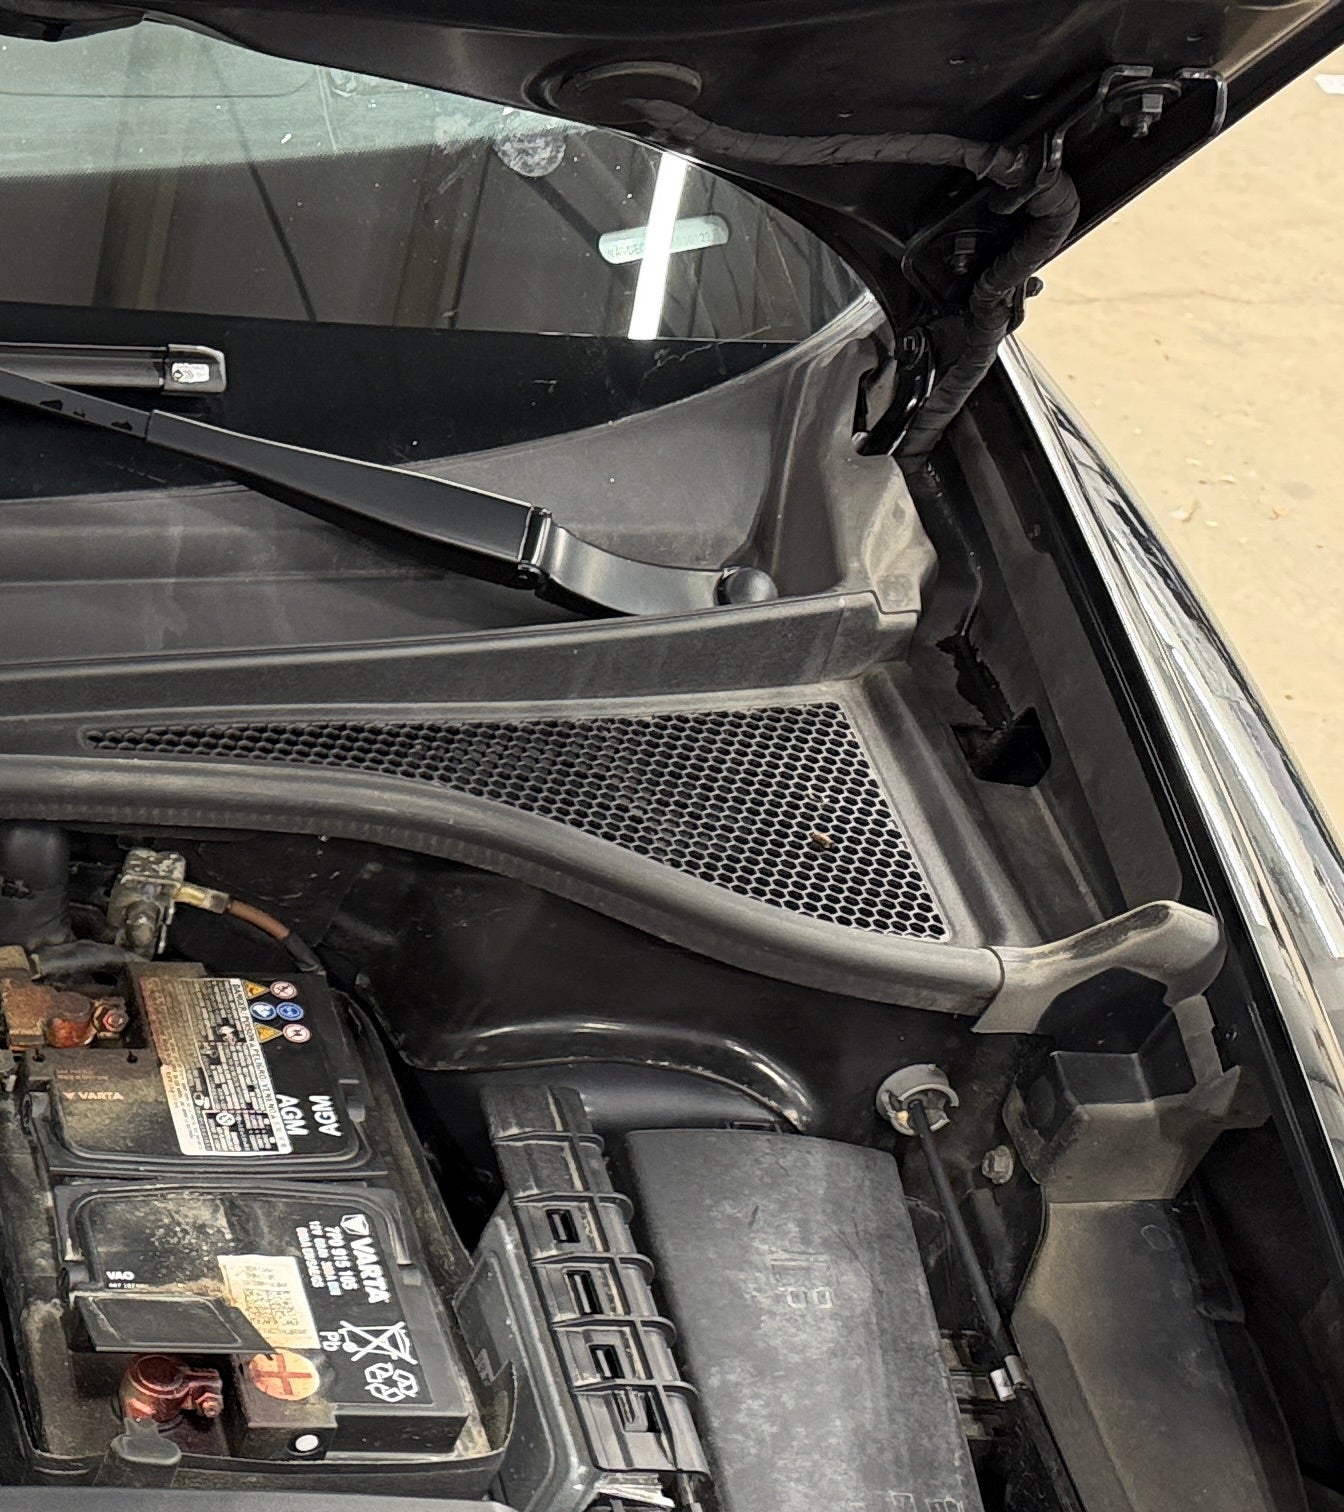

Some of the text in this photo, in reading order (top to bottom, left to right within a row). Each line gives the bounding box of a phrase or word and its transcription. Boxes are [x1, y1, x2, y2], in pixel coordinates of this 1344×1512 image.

[275, 1094, 310, 1135] AGM
[308, 1095, 343, 1137] AGM
[351, 1236, 391, 1304] VARTA
[319, 1331, 341, 1352] Pb
